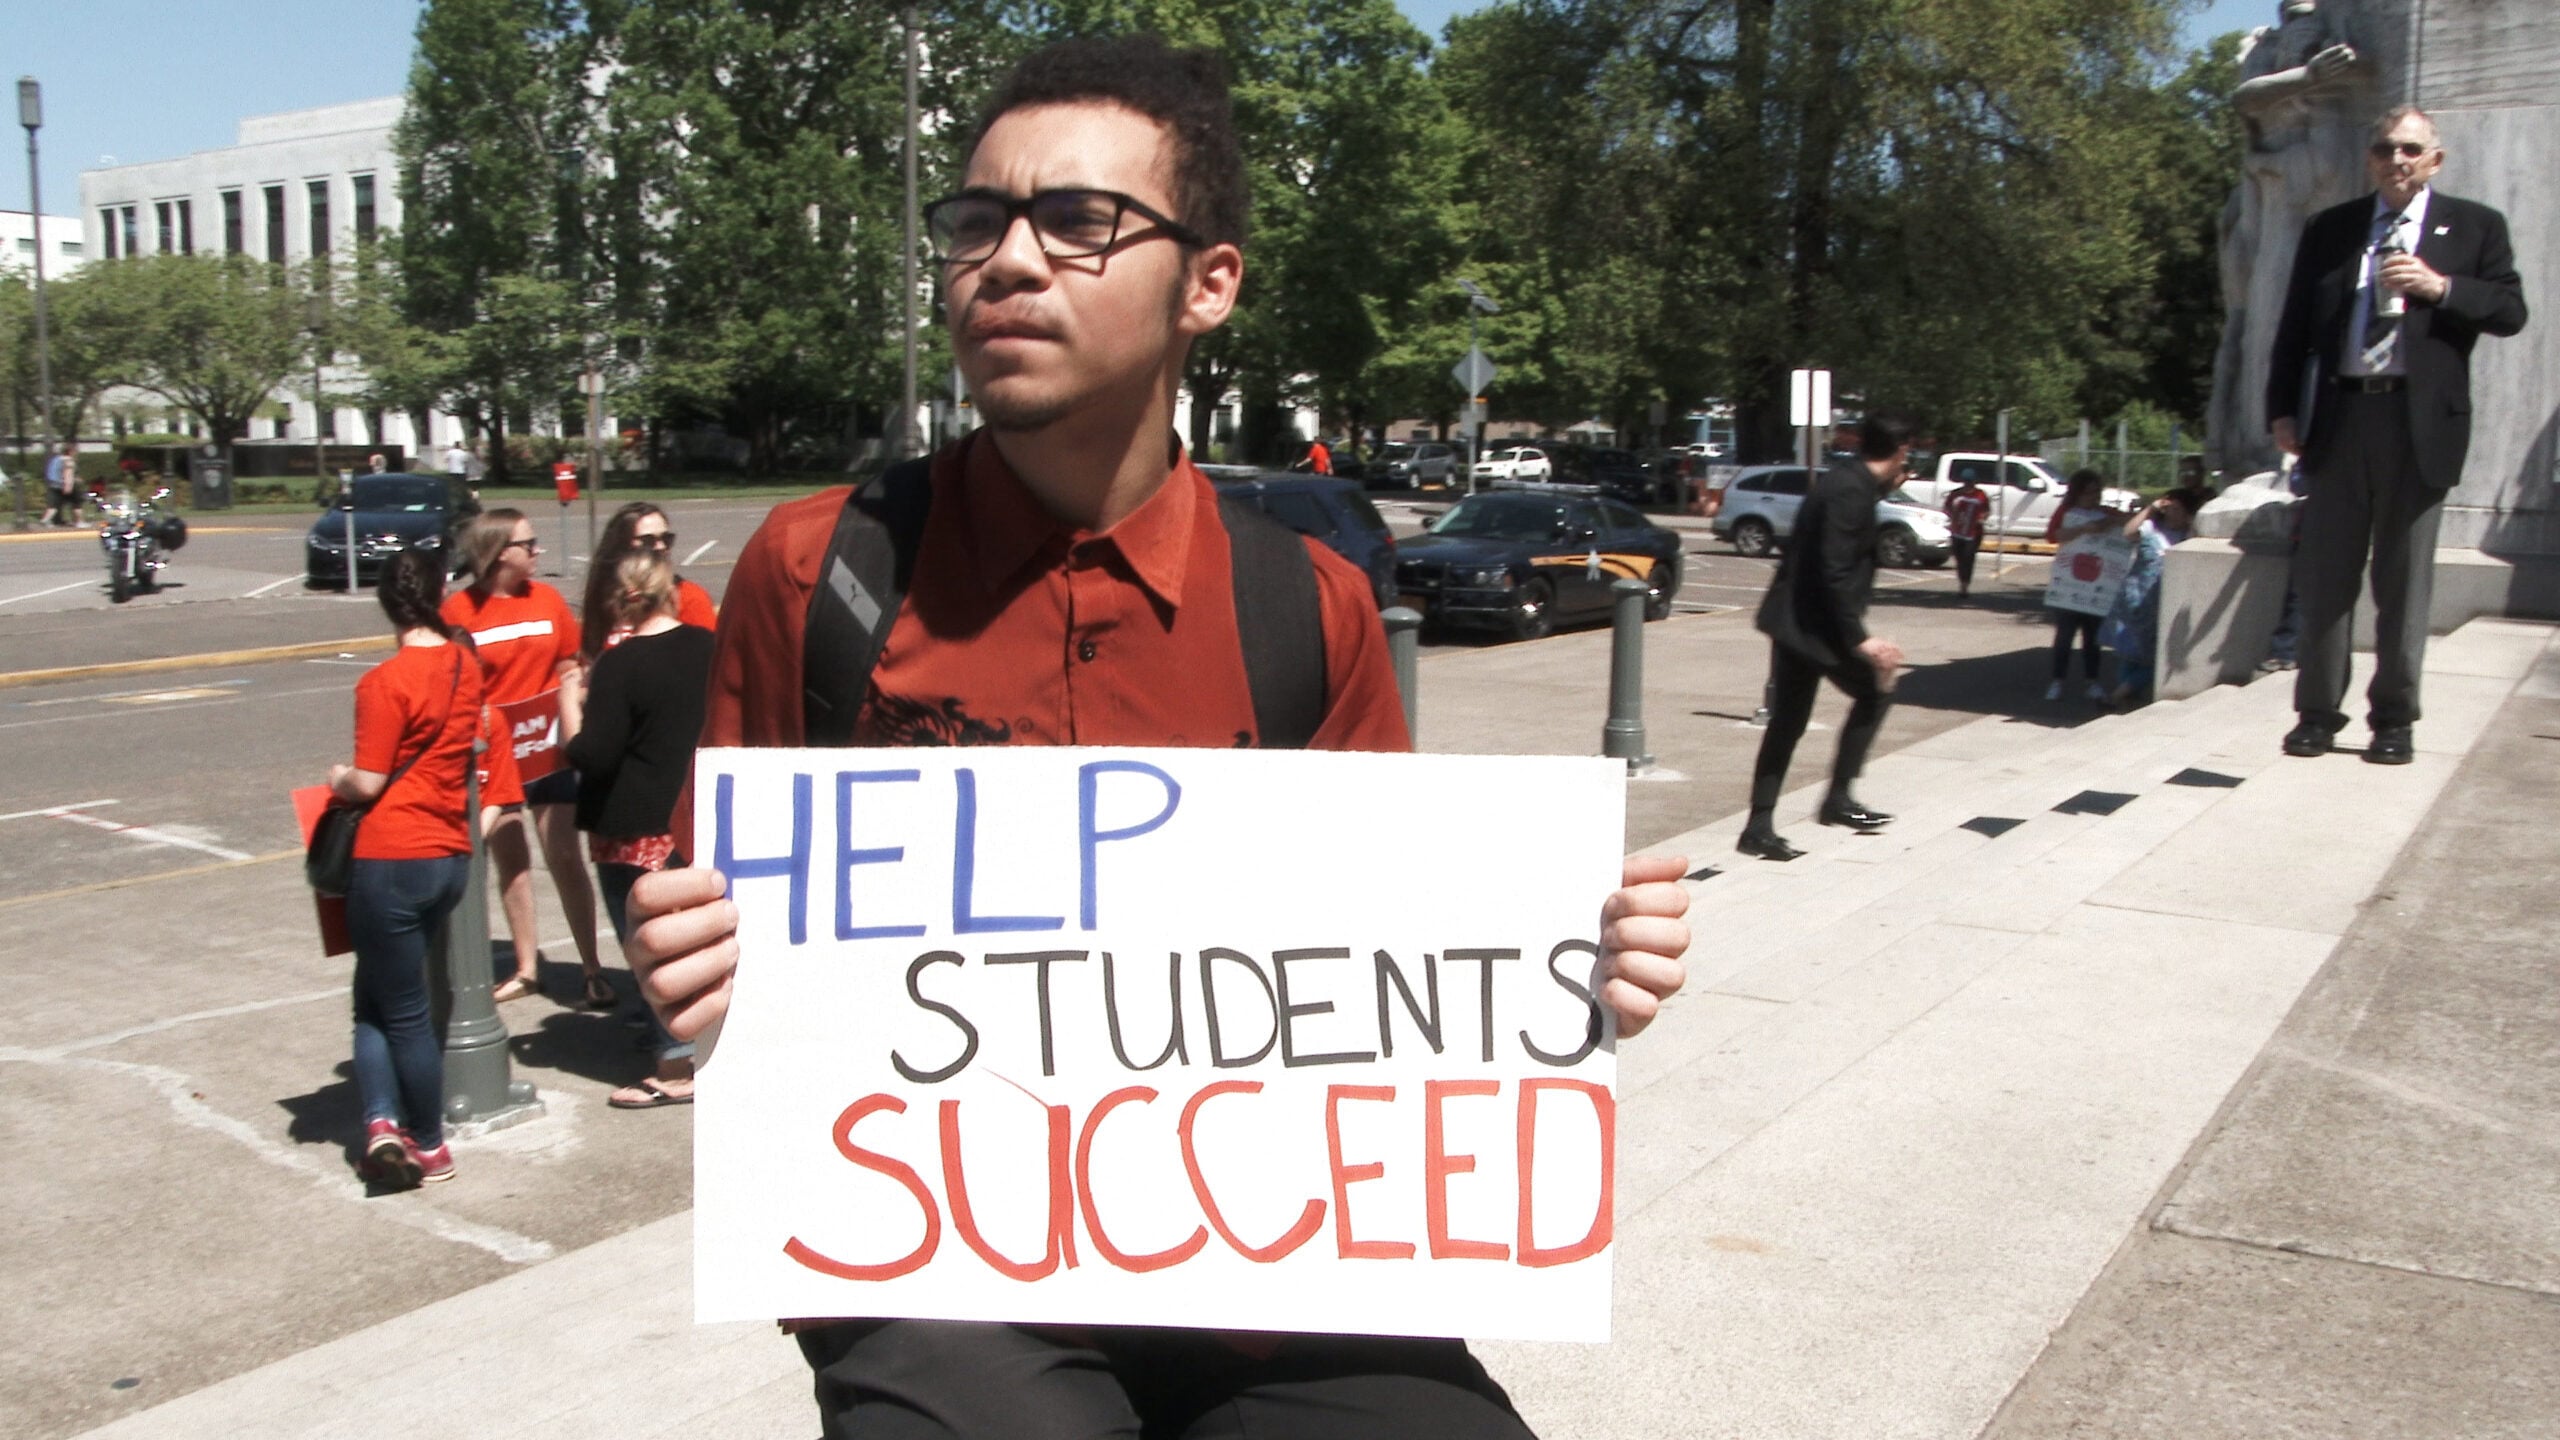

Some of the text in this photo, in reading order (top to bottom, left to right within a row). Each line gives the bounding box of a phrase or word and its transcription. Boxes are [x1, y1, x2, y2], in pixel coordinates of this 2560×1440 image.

[512, 714, 547, 738] AM
[714, 760, 1182, 945] HELP
[891, 938, 1603, 1084] STUDENTS
[783, 1078, 1617, 1283] SUCCEED
